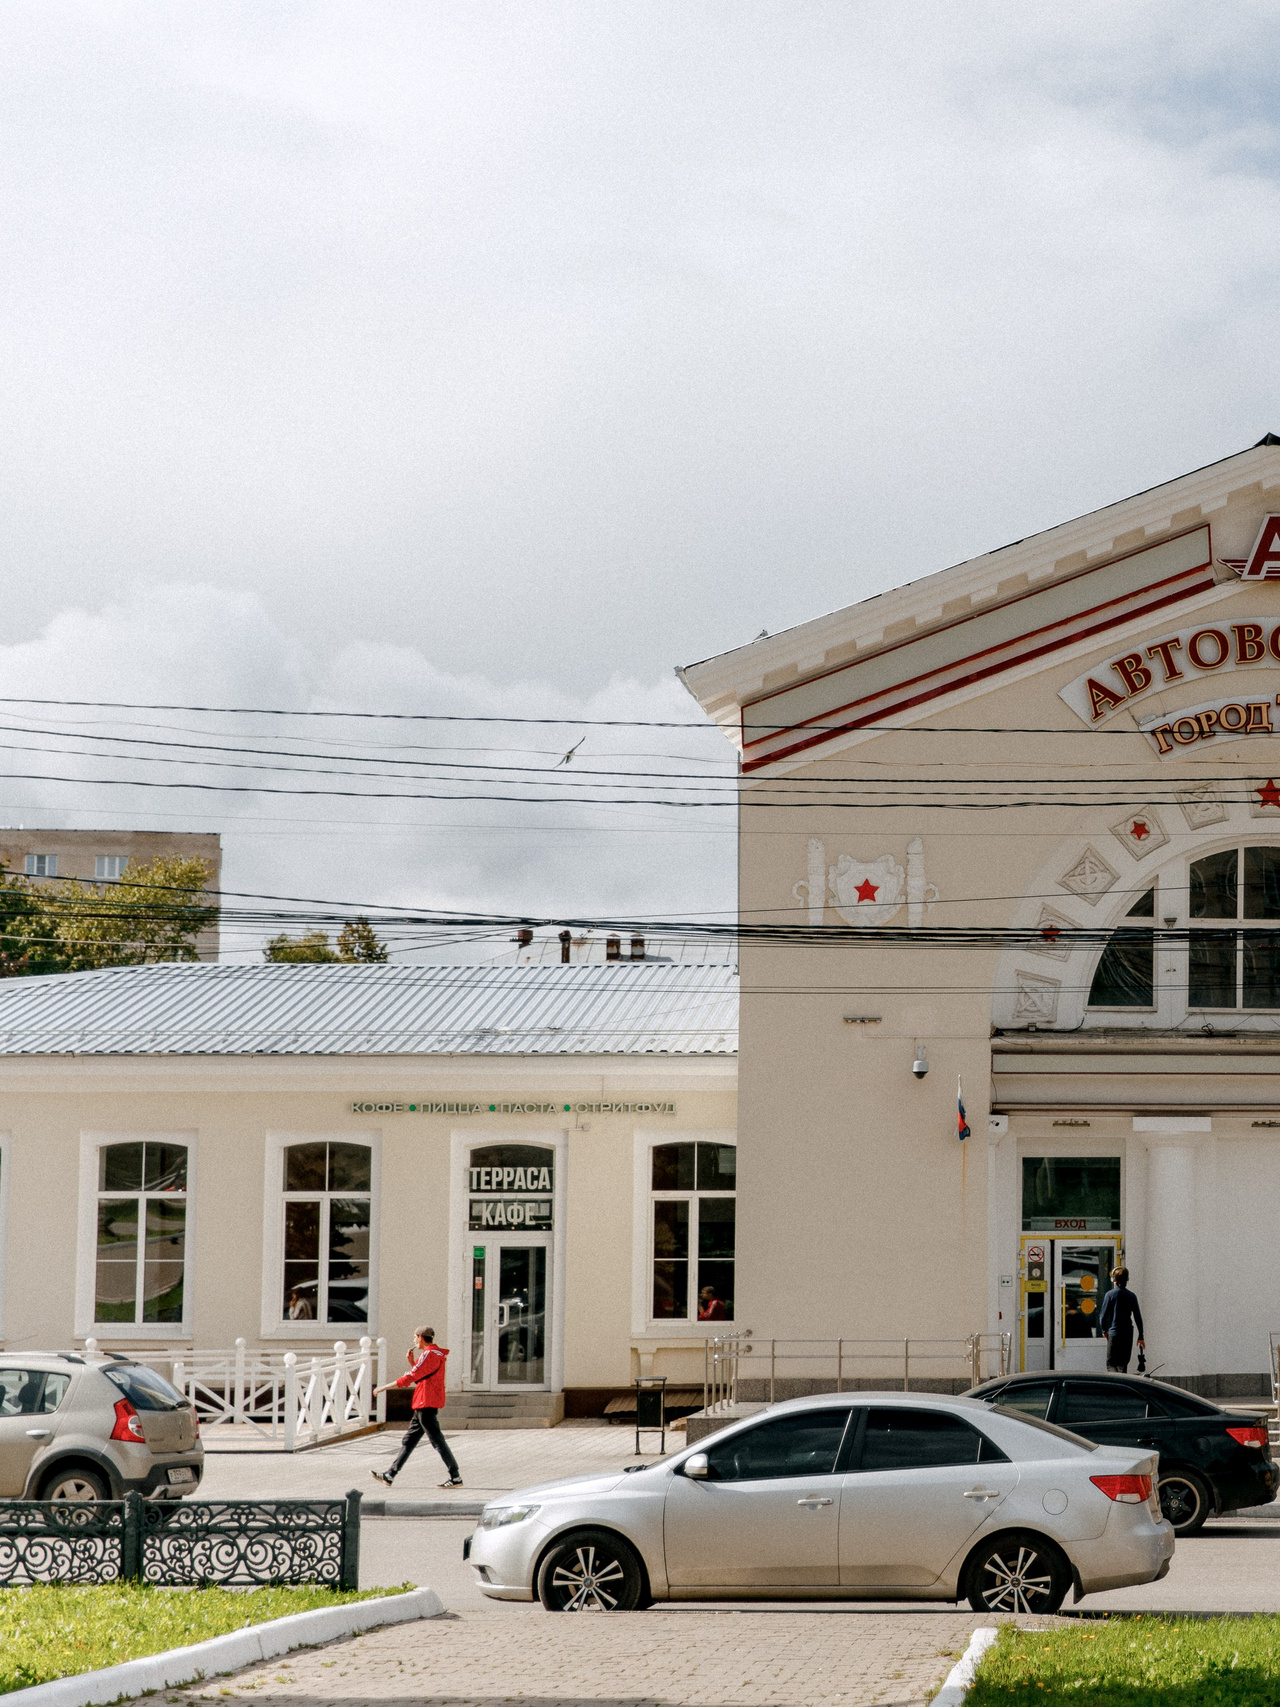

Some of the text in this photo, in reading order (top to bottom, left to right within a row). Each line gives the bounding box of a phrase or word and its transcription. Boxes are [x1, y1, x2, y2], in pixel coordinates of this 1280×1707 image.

[1151, 702, 1273, 754] ГОРОД
[351, 1102, 677, 1115] КОФЕ ПИЦЦА ПАСТА СТРИТФУД
[470, 1166, 551, 1190] ТЕРРАСА
[481, 1202, 537, 1226] КАФЕ
[1054, 1219, 1087, 1230] ВХОД
